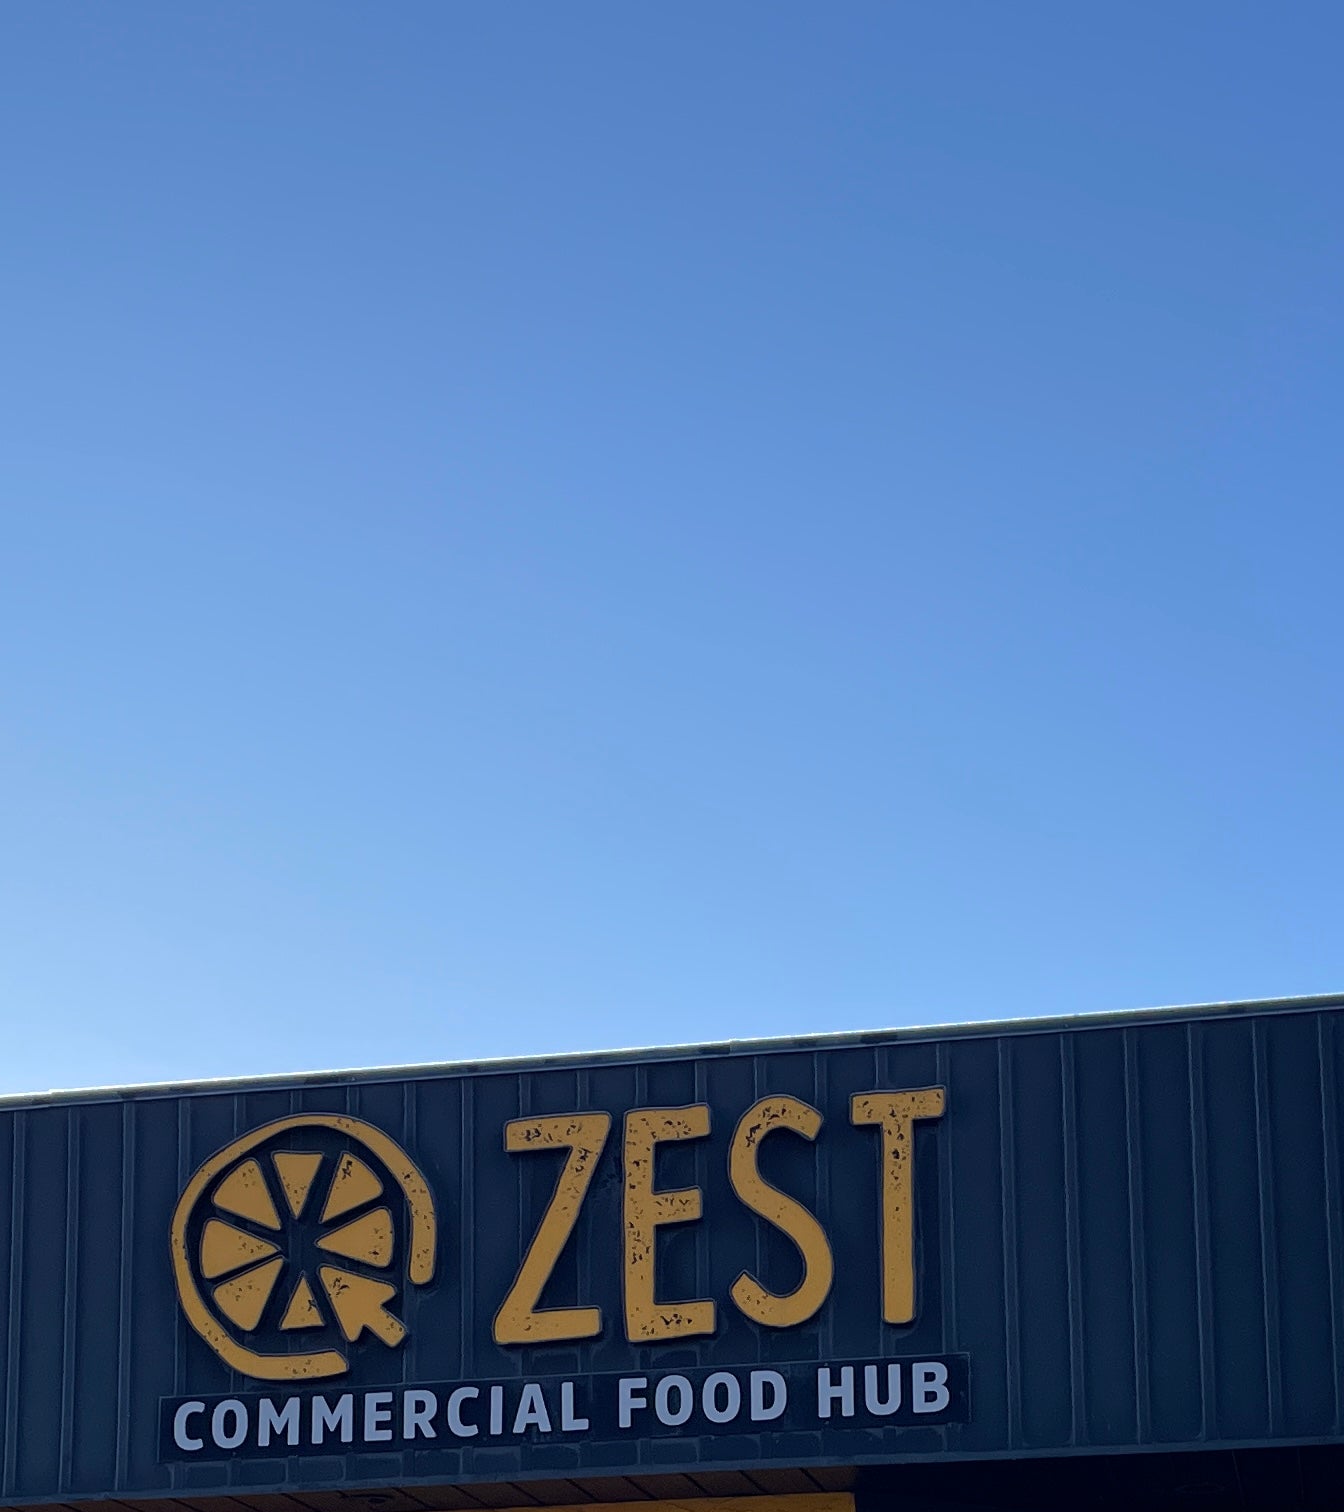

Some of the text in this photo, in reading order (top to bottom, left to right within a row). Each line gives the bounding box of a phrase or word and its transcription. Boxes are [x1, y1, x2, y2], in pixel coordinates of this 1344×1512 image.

[493, 1085, 946, 1345] ZEST
[172, 1361, 952, 1452] COMMERCIAL FOOD HUB
